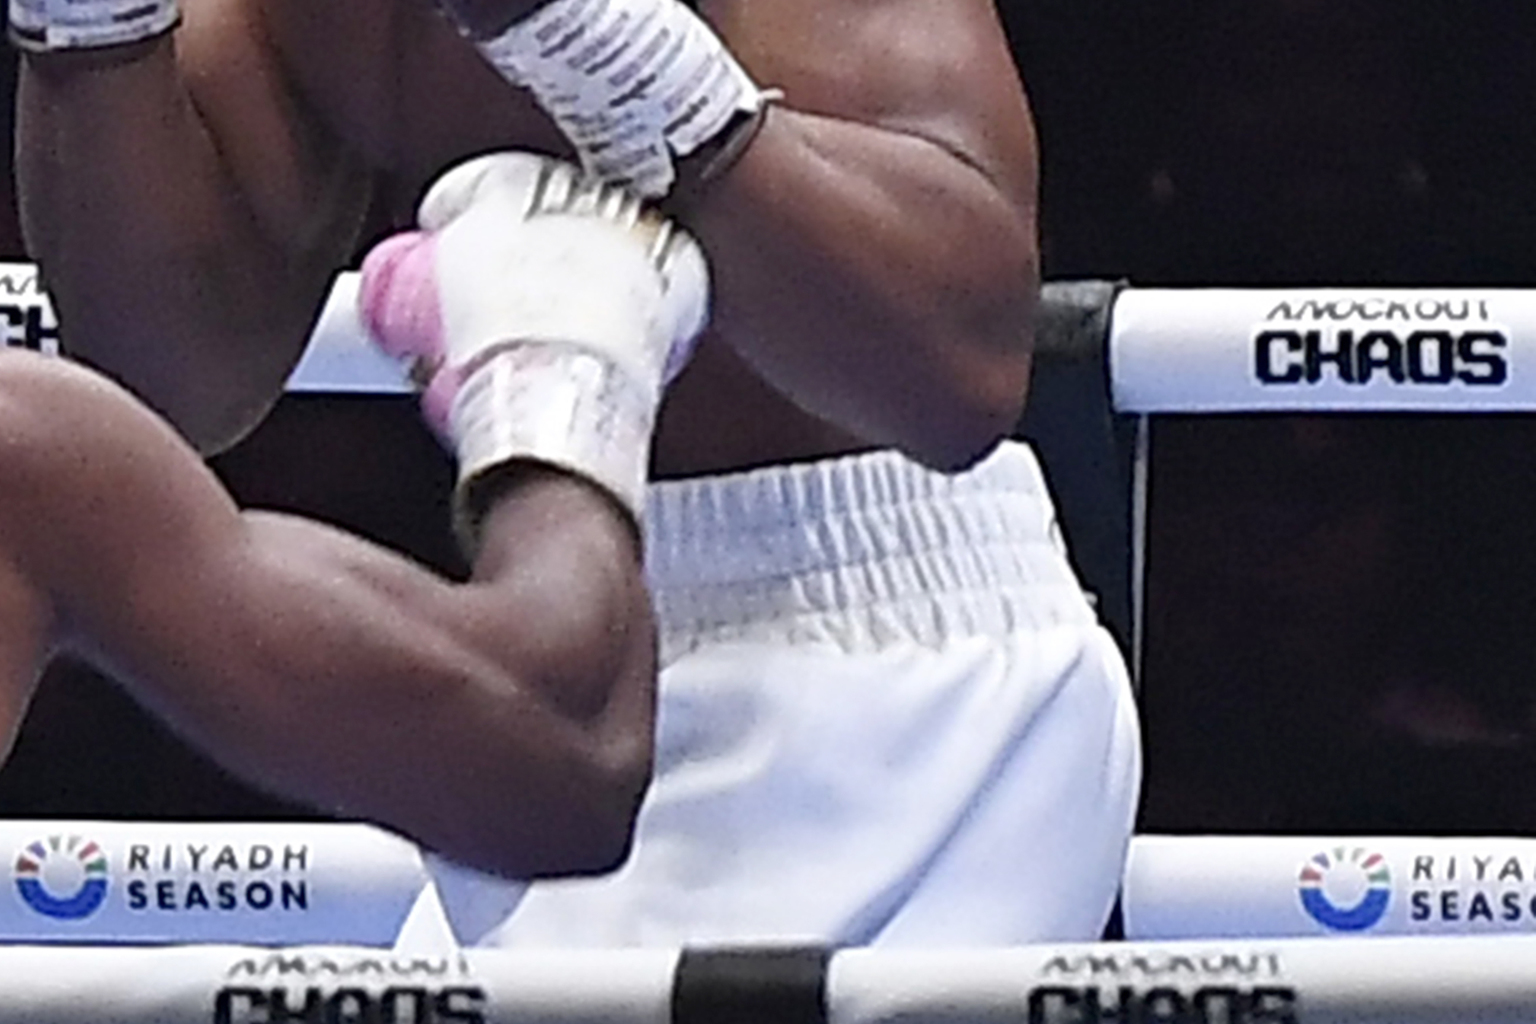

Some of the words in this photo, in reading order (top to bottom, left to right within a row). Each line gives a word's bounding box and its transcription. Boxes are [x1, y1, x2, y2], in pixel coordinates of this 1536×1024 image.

[1255, 330, 1508, 386] CHAOS
[128, 844, 308, 872] RIYADH
[1413, 855, 1536, 881] RIYA
[127, 879, 308, 911] SEASON
[1411, 890, 1536, 922] SEAS
